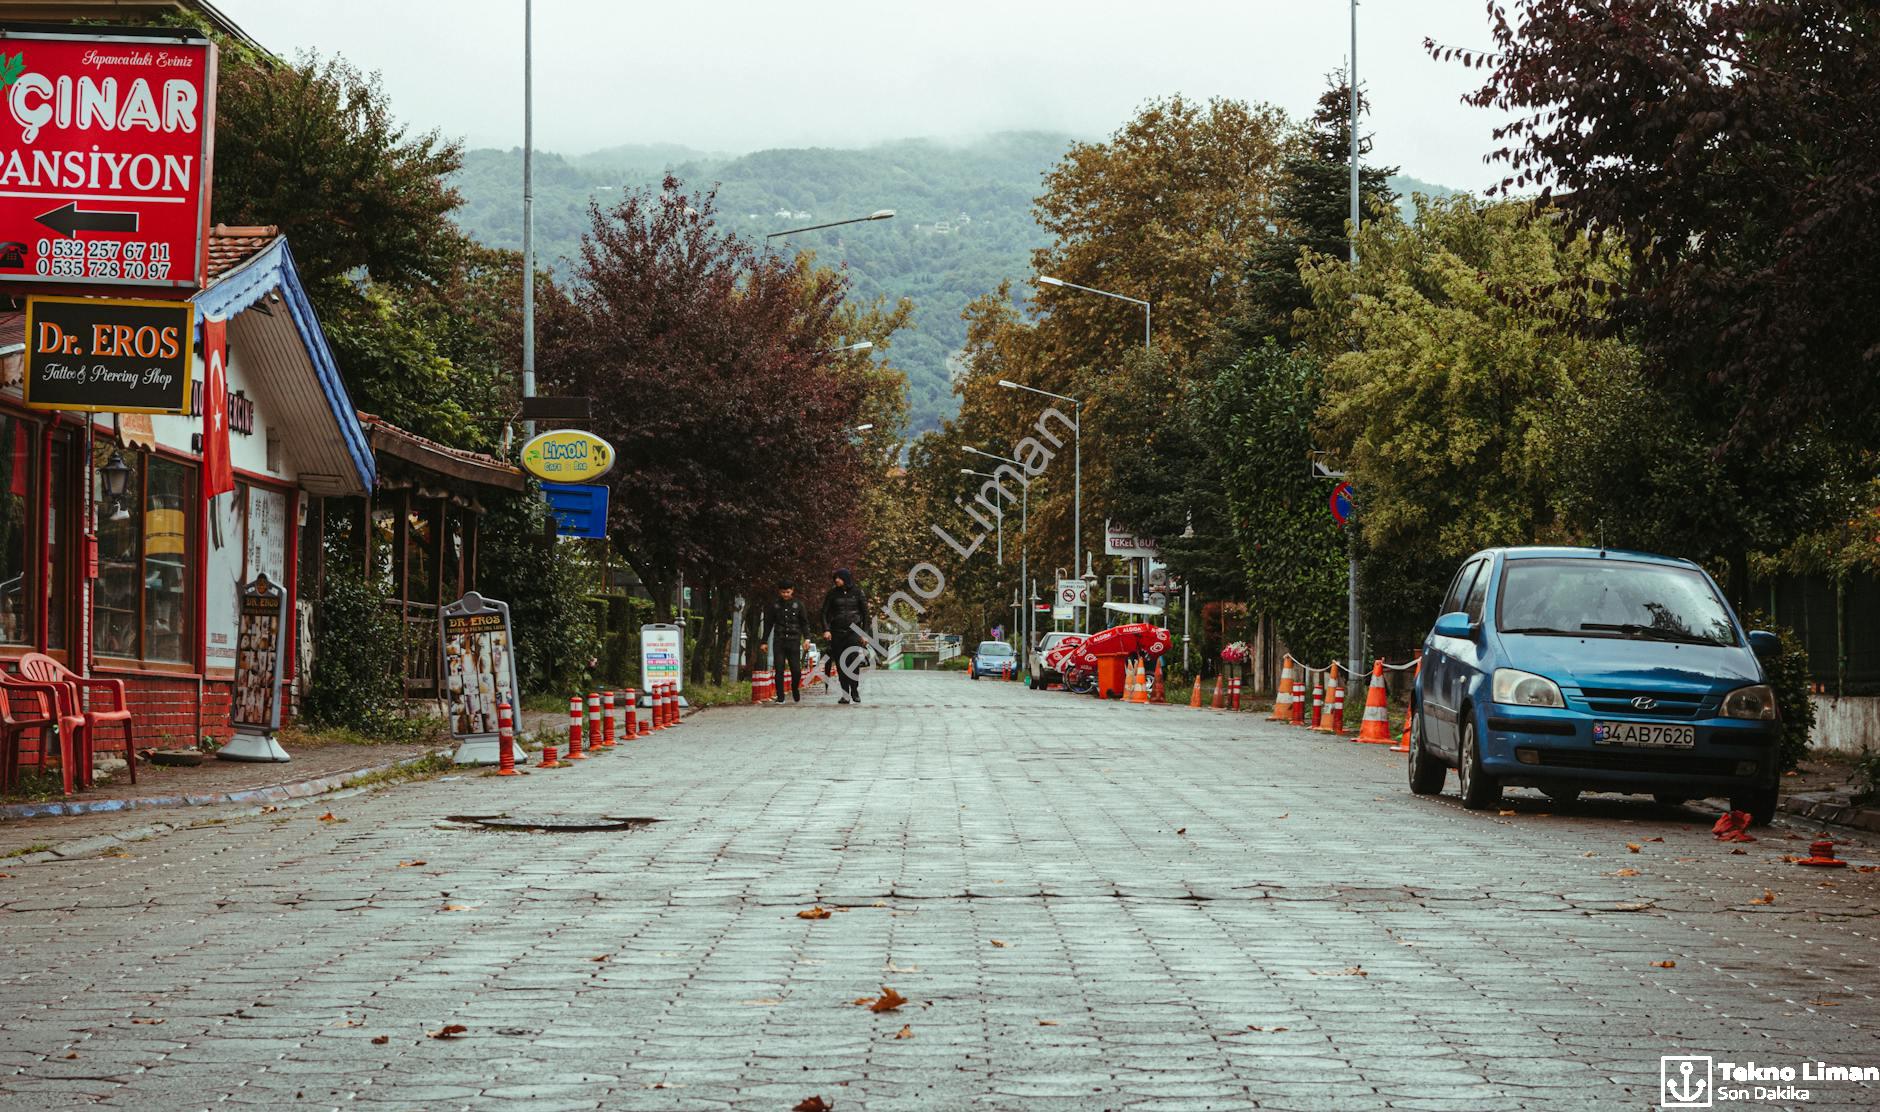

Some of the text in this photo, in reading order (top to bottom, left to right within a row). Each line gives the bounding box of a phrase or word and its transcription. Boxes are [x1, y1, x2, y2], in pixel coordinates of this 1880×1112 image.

[81, 49, 193, 70] Sapanca'daki Eviniz
[9, 72, 198, 145] ÇINAR
[0, 145, 194, 191] ANSİYON
[37, 238, 170, 260] 0 532 257 67 11
[36, 257, 170, 279] 0 535 728 70 97
[37, 322, 180, 359] Dr. EROS
[89, 364, 140, 390] Piercing
[142, 367, 173, 390] Shop
[471, 615, 500, 626] EROS
